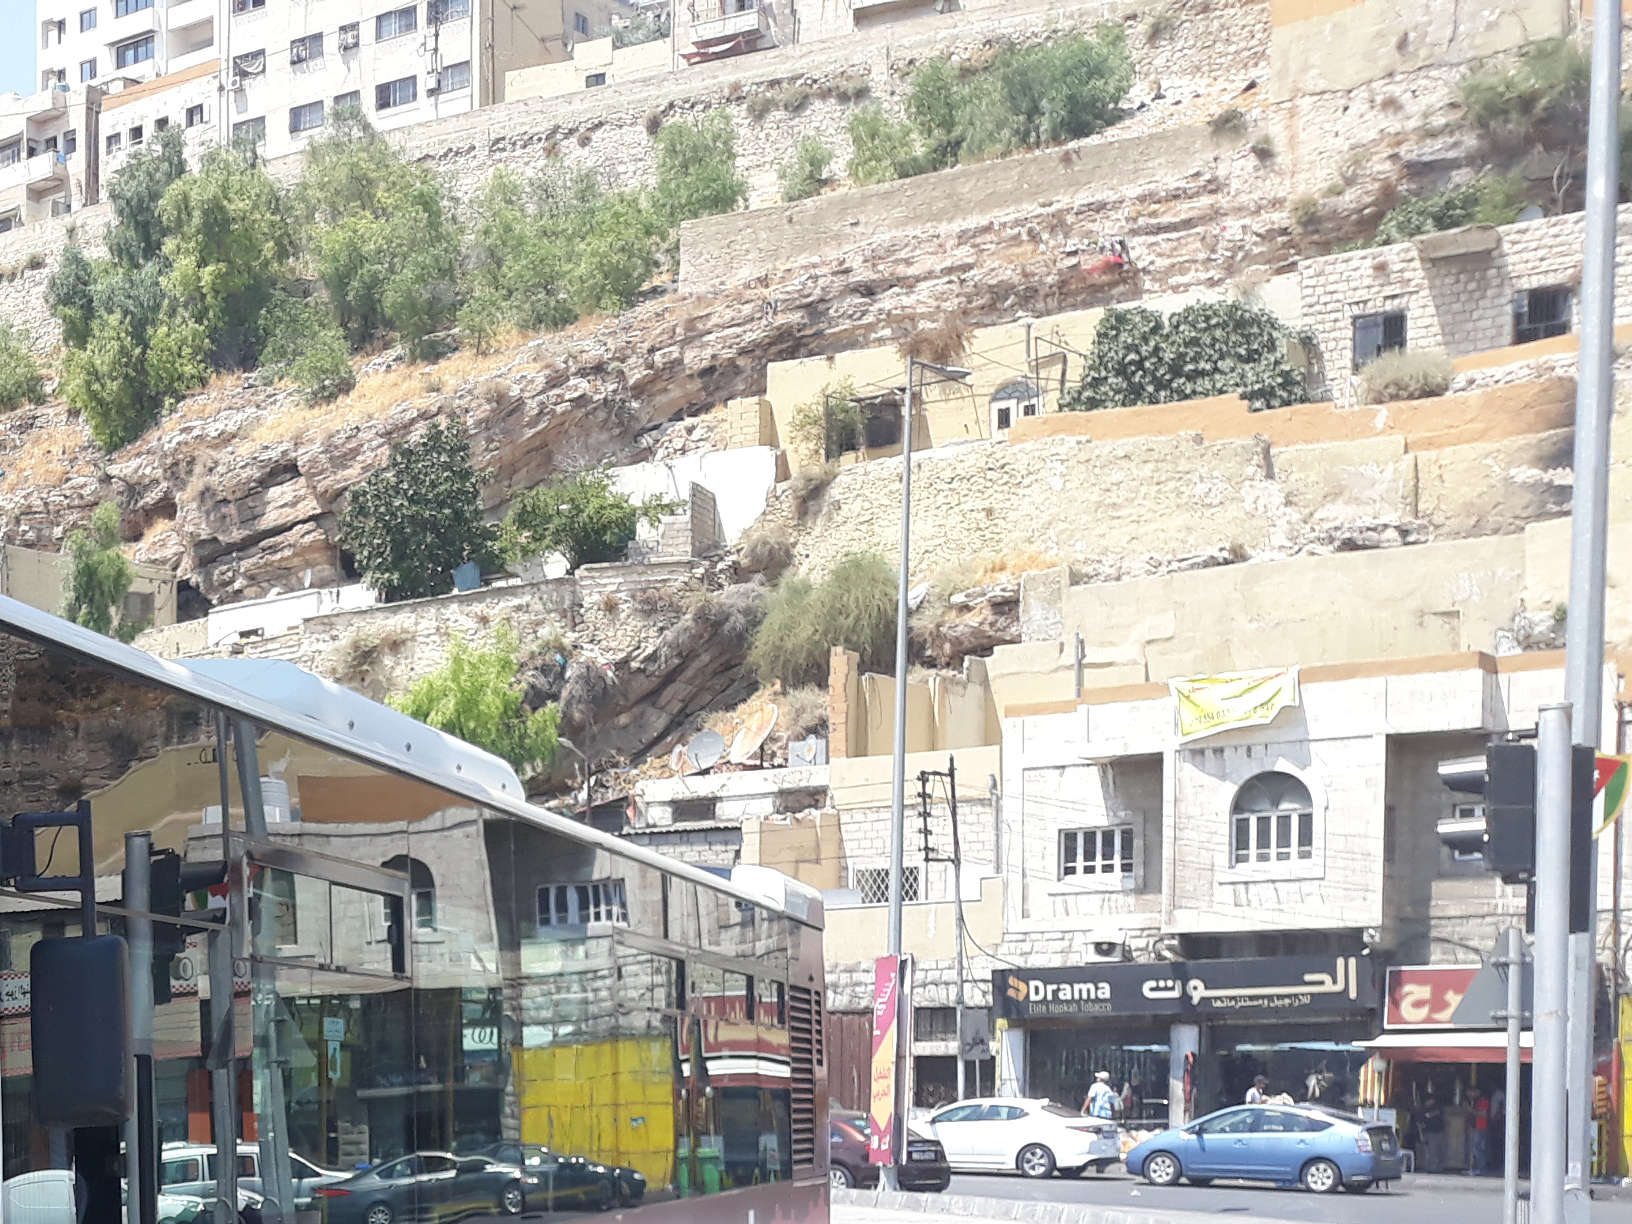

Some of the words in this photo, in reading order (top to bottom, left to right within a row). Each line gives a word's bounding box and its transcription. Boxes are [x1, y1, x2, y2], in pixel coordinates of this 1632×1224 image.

[1028, 979, 1111, 1002] Drama
[1049, 1002, 1079, 1014] Hookah
[1081, 1000, 1112, 1012] Tobacco
